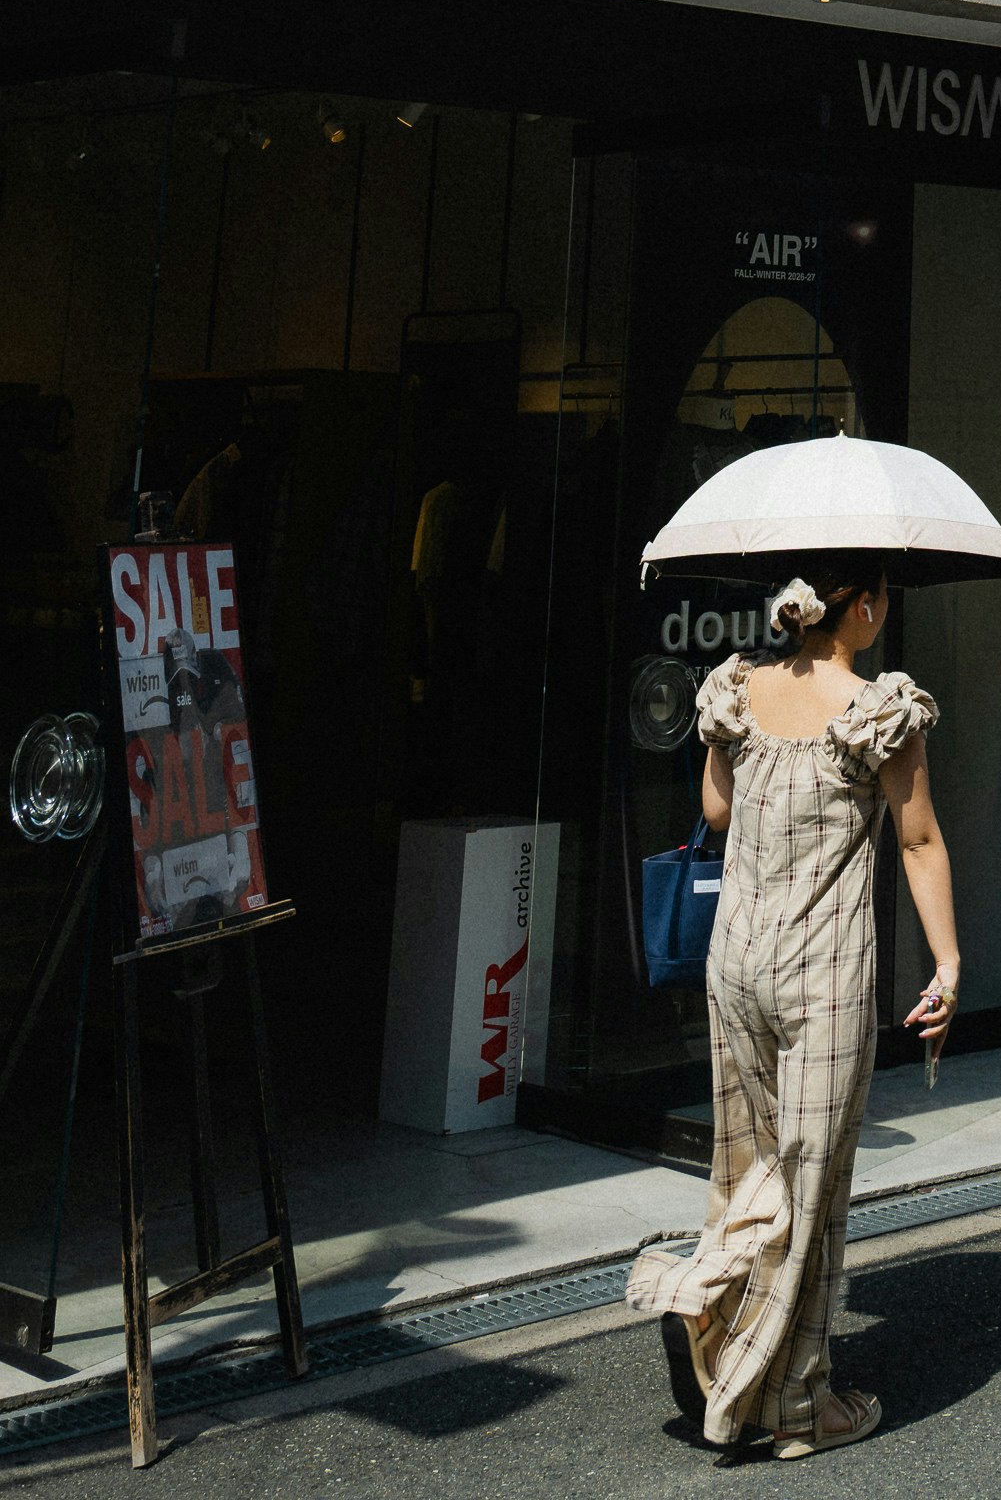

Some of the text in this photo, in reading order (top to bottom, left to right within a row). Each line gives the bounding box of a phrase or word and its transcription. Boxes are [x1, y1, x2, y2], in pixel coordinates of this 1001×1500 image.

[734, 268, 816, 282] FALL-WINTER 2026-27
[735, 231, 818, 267] “AIR”
[110, 549, 241, 660] SALE
[126, 670, 160, 693] wism
[176, 690, 193, 706] sale
[126, 723, 257, 849] SALE
[172, 857, 199, 877] wism
[512, 841, 532, 928] archive
[477, 927, 531, 1105] WR
[505, 993, 521, 1097] WILLY GARAGE
